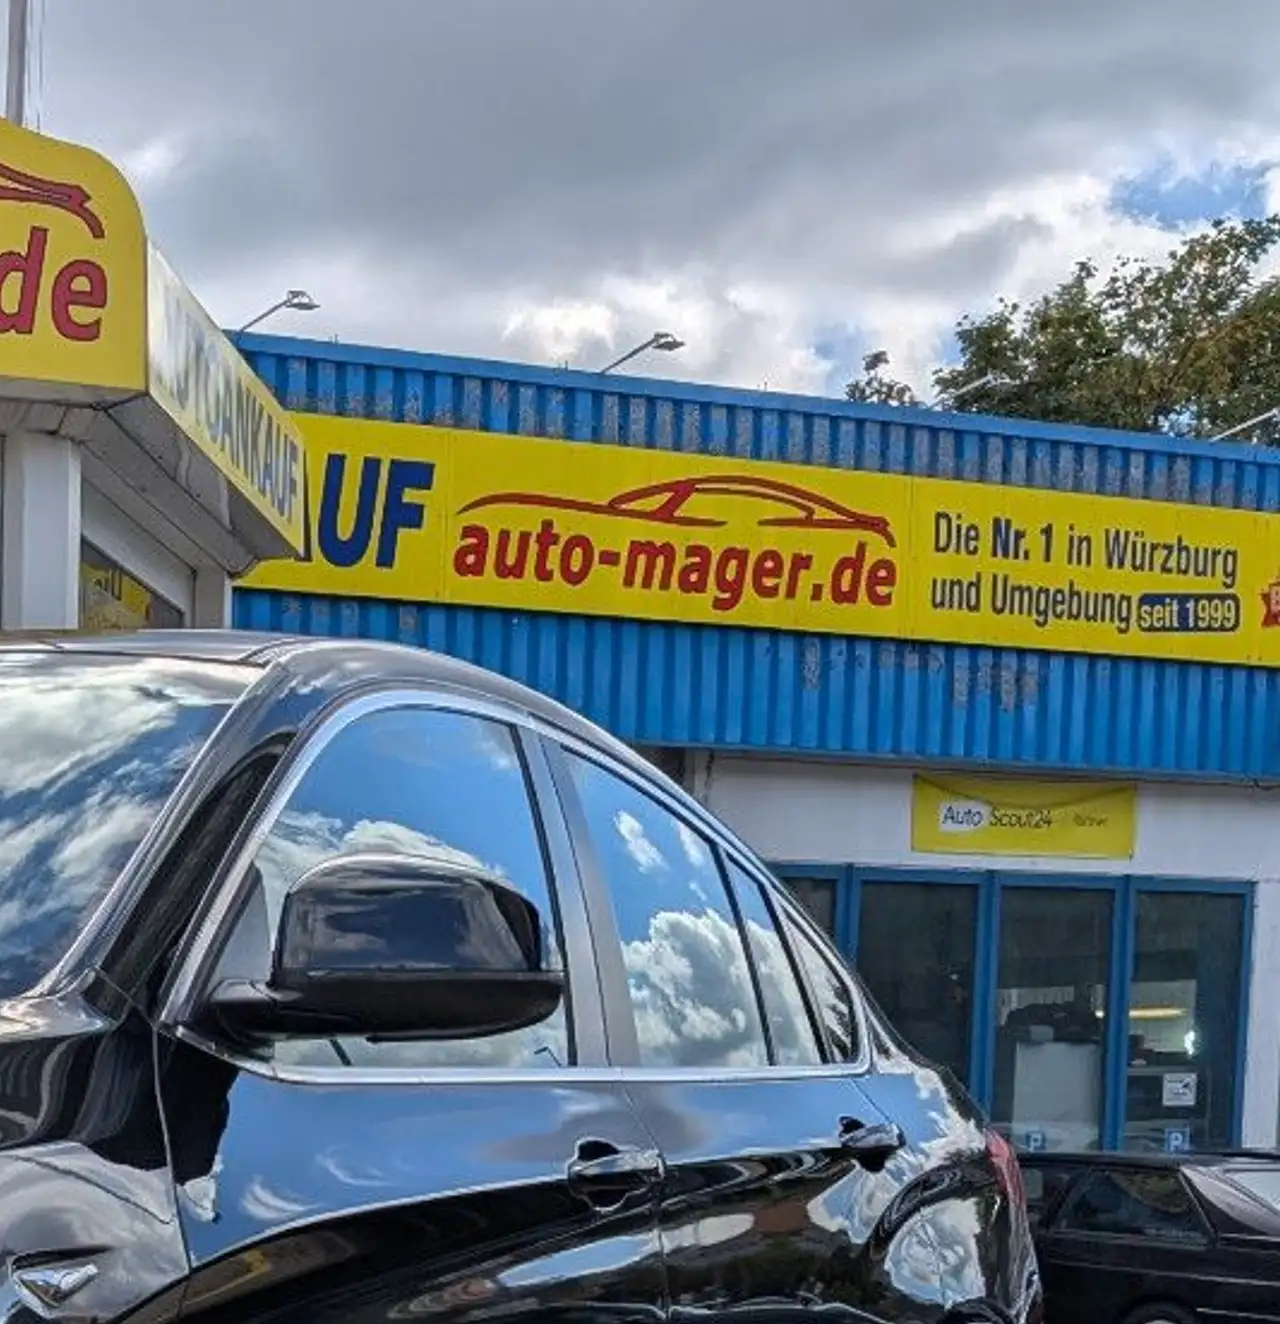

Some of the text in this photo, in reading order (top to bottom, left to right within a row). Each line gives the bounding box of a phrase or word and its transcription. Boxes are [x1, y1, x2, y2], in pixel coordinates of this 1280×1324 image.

[453, 518, 898, 611] auto-mager.de
[934, 511, 1239, 589] Die Nr. 1 in Würzburg
[931, 572, 1236, 634] und Umgebung seit 1999
[942, 805, 984, 827] Auto
